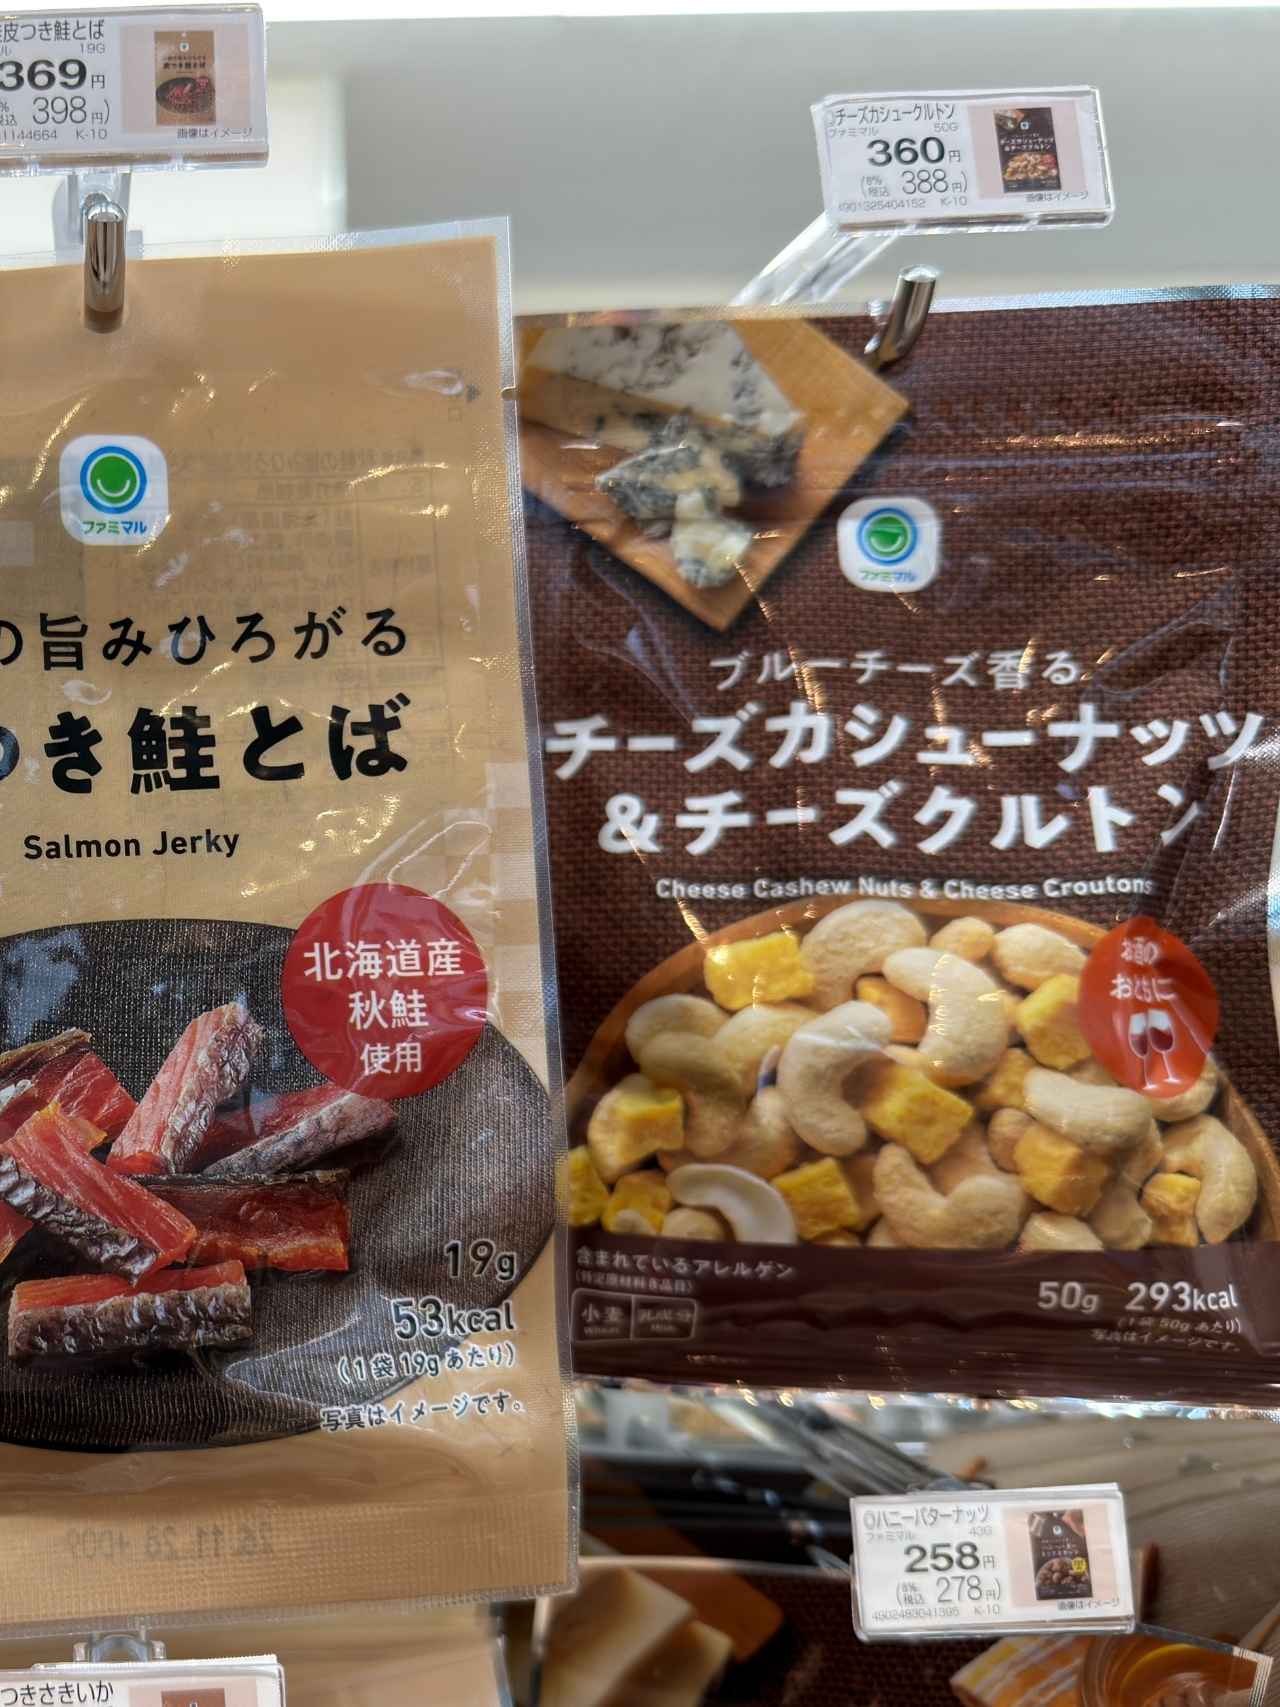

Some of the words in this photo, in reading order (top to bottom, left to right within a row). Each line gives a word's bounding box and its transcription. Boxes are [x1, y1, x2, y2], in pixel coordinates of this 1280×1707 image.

[82, 519, 147, 536] ファミマル
[710, 648, 1083, 690] ブルーチーズ香る
[545, 702, 1264, 781] チーズカシューナッツ
[598, 779, 1207, 855] &チーズクルトン
[24, 834, 141, 859] Salmon
[152, 828, 240, 858] Jerky
[656, 878, 745, 898] Cheese
[754, 878, 851, 897] Cashew
[858, 877, 913, 897] Nuts
[920, 880, 935, 896] &
[944, 880, 1037, 899] Cheese
[1043, 876, 1153, 897] Croutons
[303, 938, 464, 982] 北海道産
[348, 989, 429, 1030] 秋鮭
[360, 1042, 421, 1076] 使用
[445, 1240, 516, 1280] 19g
[1037, 1281, 1100, 1313] 50g
[1126, 1281, 1238, 1312] 293kcal
[392, 1297, 515, 1339] 53kcal
[322, 1392, 523, 1432] 写真はイメージです。
